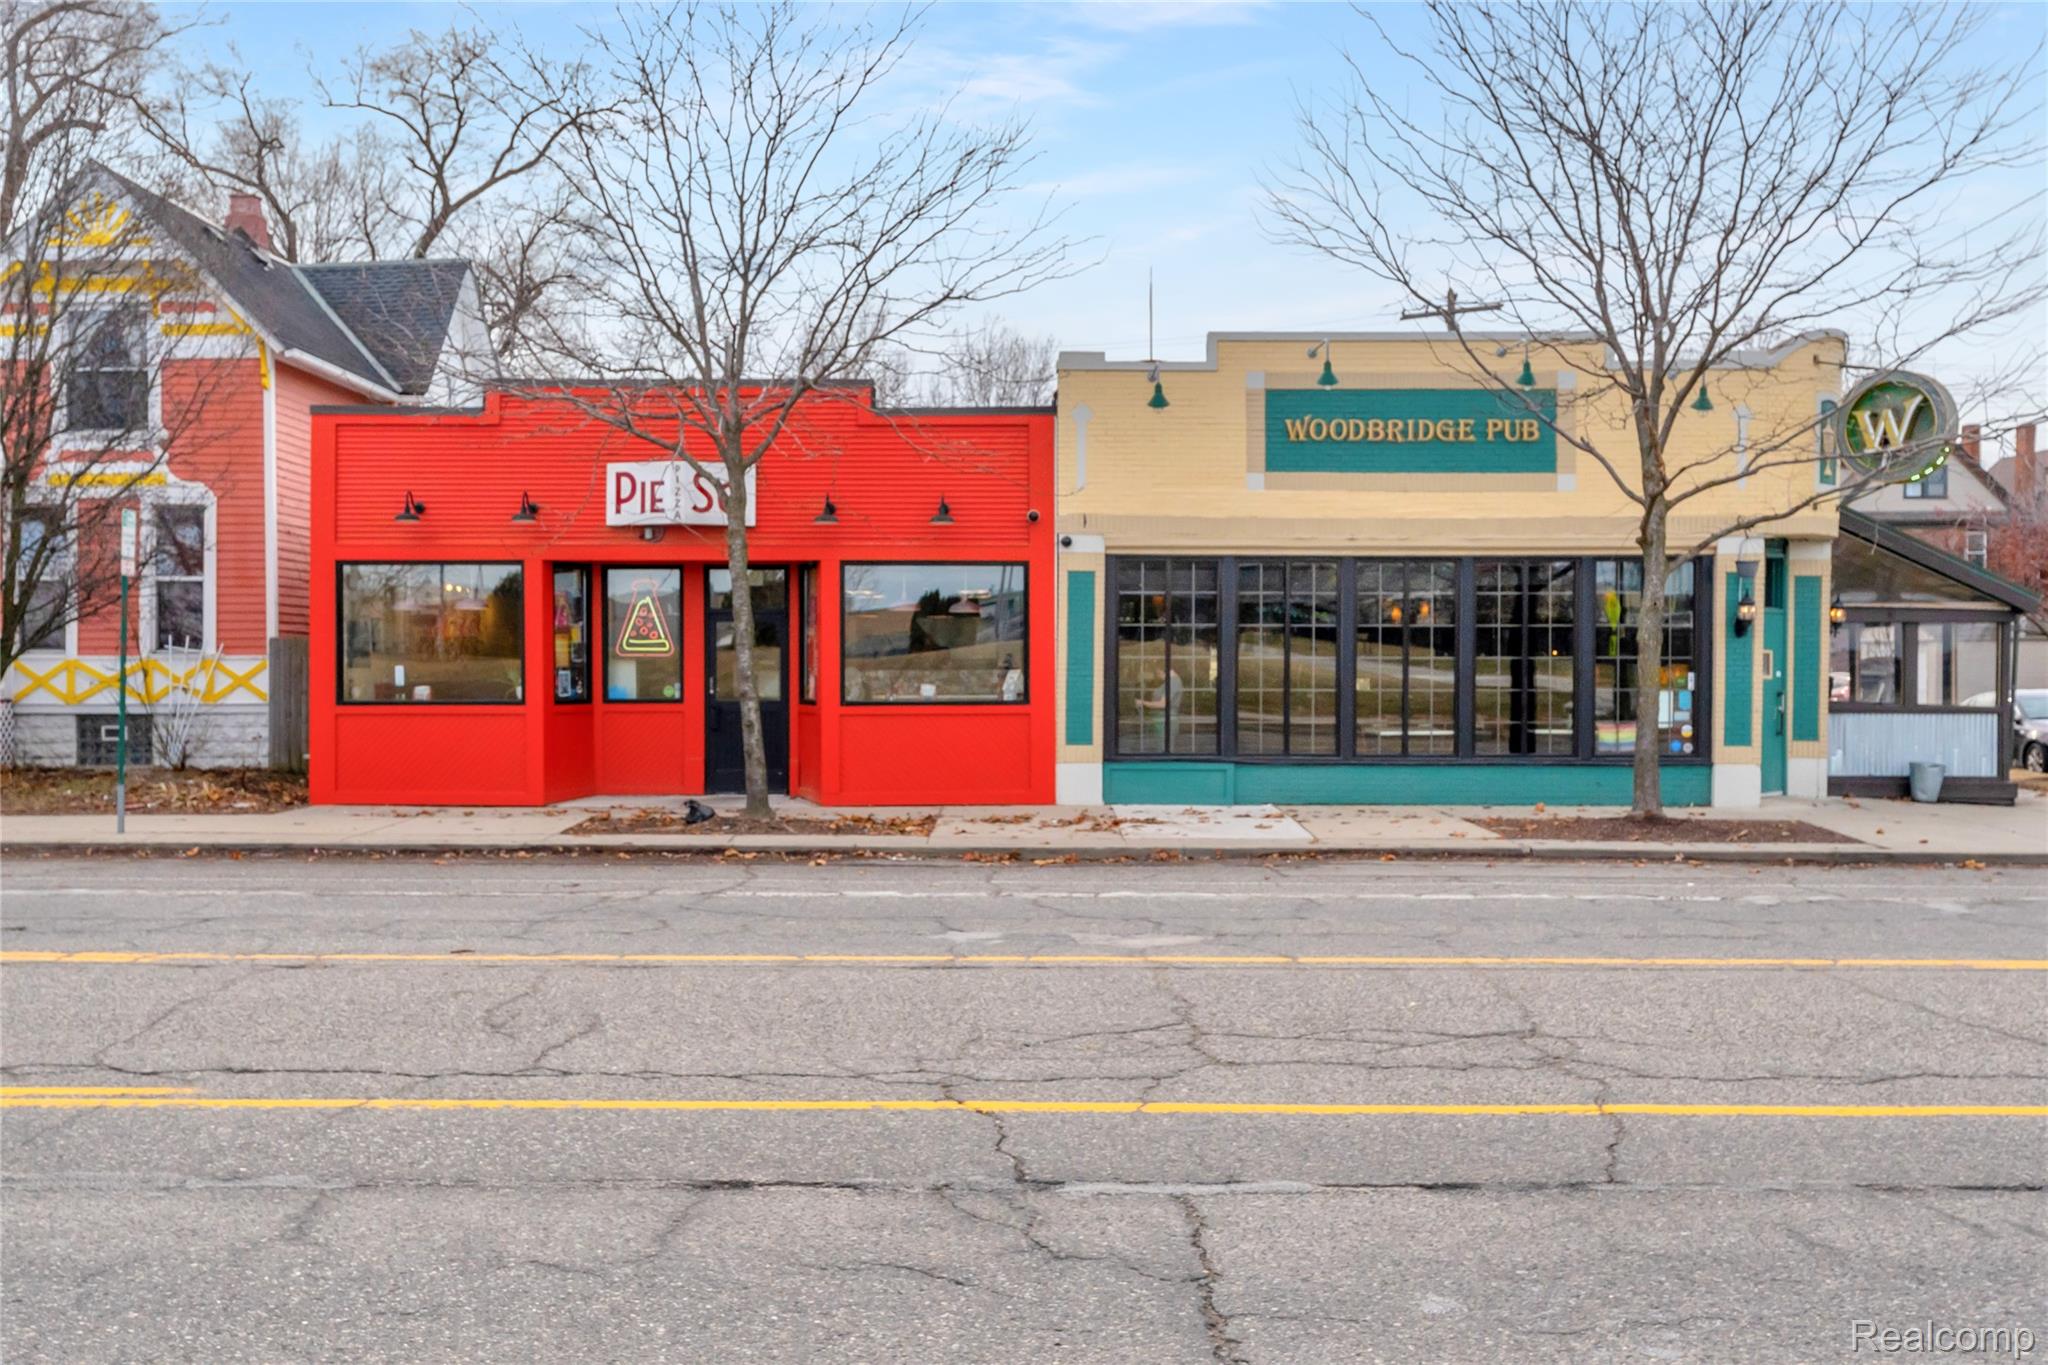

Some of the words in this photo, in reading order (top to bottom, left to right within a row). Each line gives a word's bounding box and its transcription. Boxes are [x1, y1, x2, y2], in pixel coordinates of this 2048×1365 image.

[1285, 414, 1476, 443] WOODBRIDGE
[1486, 418, 1541, 442] PUB
[1852, 394, 1925, 453] W
[615, 472, 665, 514] PIE
[674, 465, 682, 521] PIZZA
